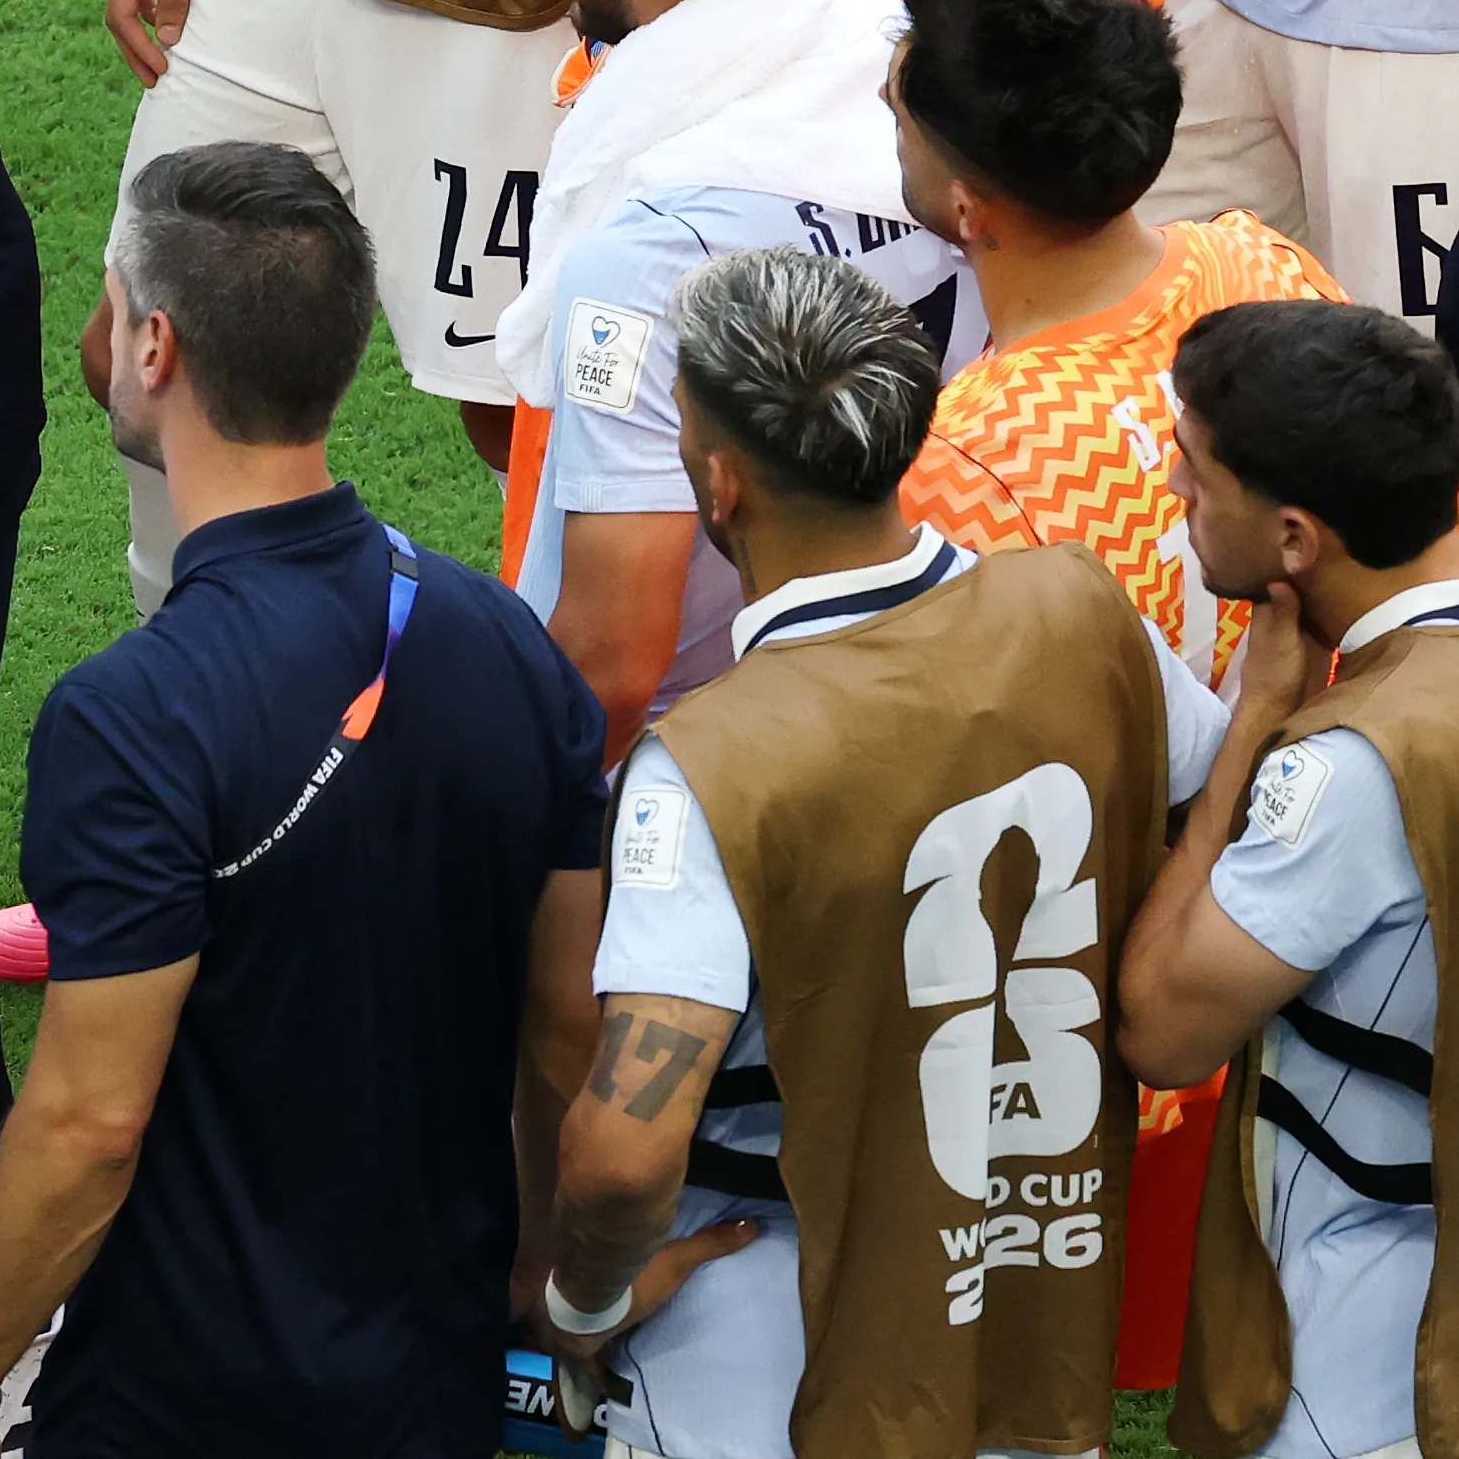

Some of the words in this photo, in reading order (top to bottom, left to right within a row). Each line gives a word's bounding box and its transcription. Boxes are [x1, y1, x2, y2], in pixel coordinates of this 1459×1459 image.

[433, 157, 539, 299] 24
[1393, 182, 1454, 317] 6
[575, 363, 614, 386] PEACE
[579, 384, 602, 395] FIFA
[311, 746, 344, 785] FIFA
[272, 783, 319, 840] WORLD
[585, 1011, 707, 1123] 17
[1019, 1167, 1104, 1208] CUP
